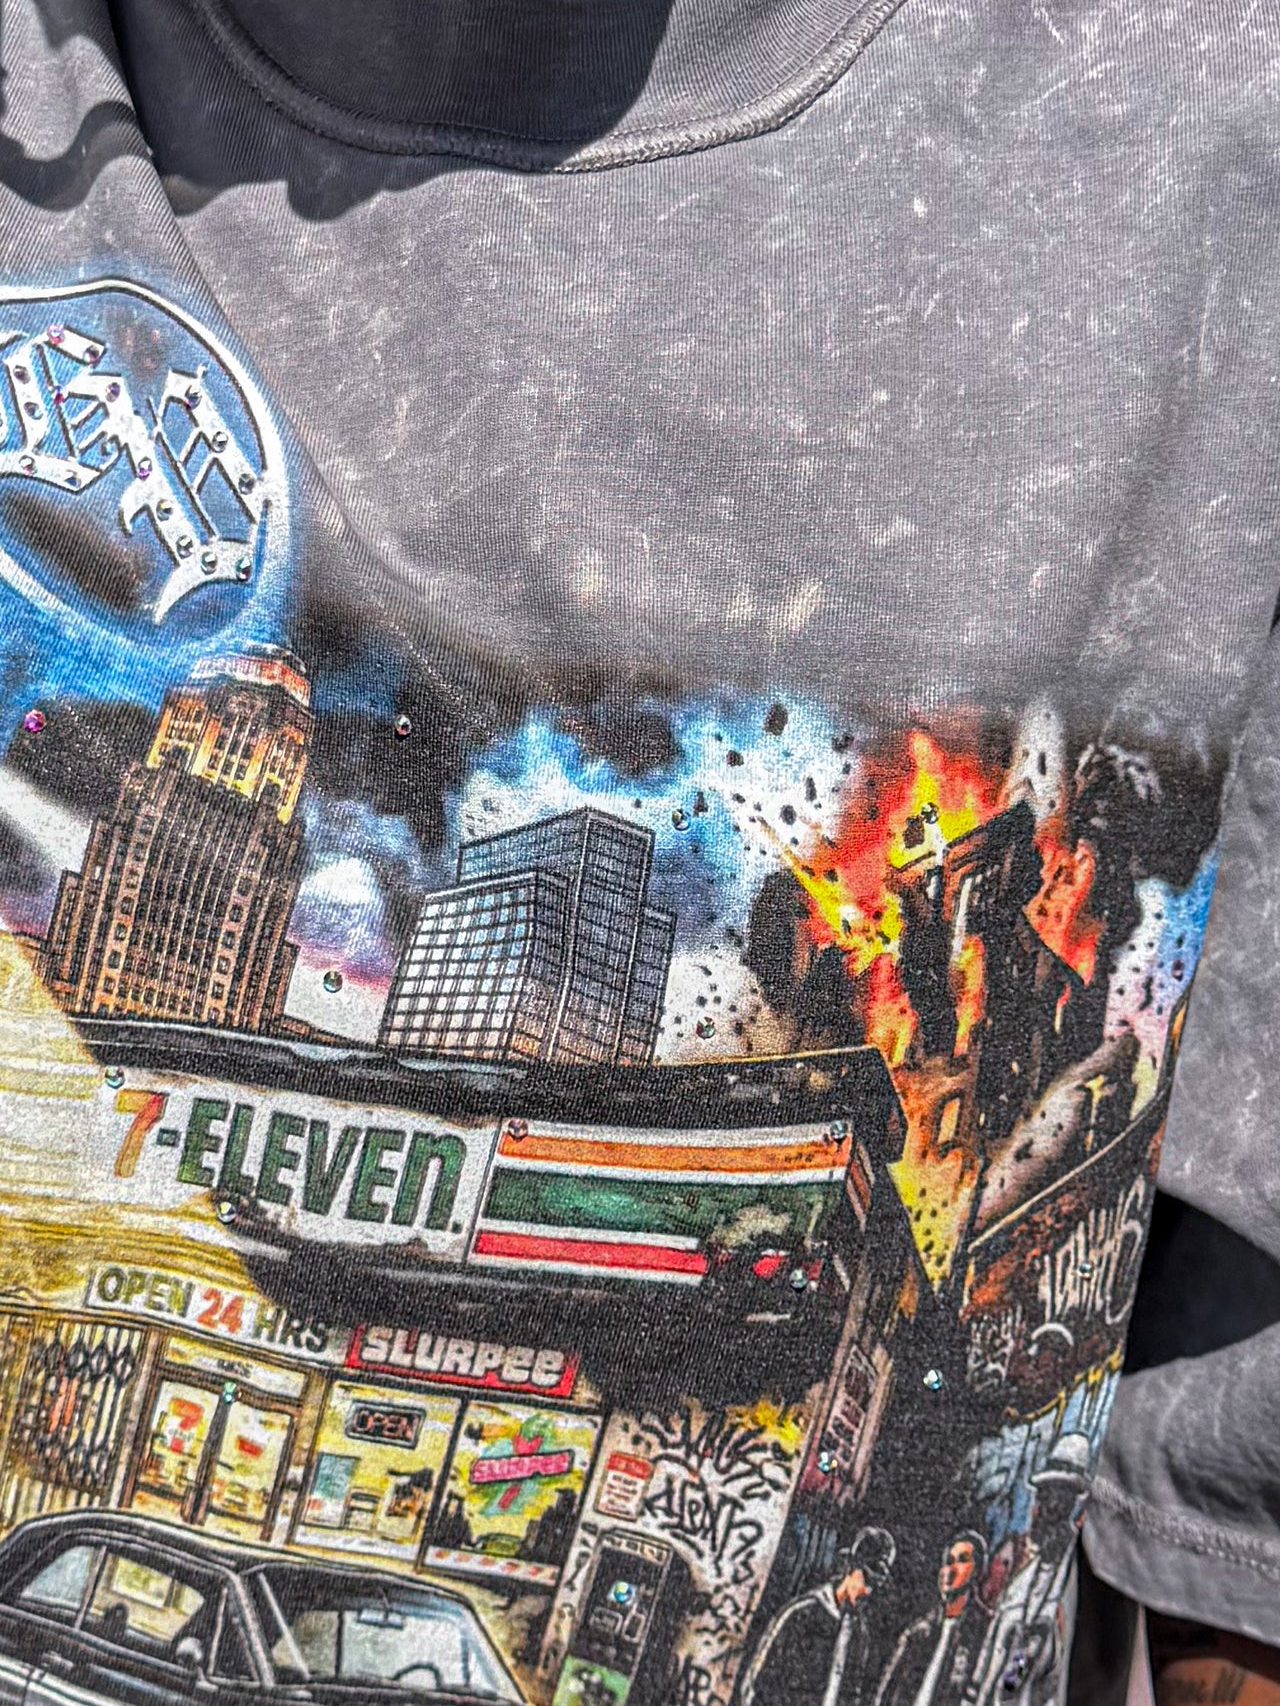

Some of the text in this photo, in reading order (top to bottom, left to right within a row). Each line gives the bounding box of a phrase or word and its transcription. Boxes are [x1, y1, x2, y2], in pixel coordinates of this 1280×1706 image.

[97, 1265, 330, 1354] OPEN 24 HRS
[355, 1408, 419, 1442] OPEN
